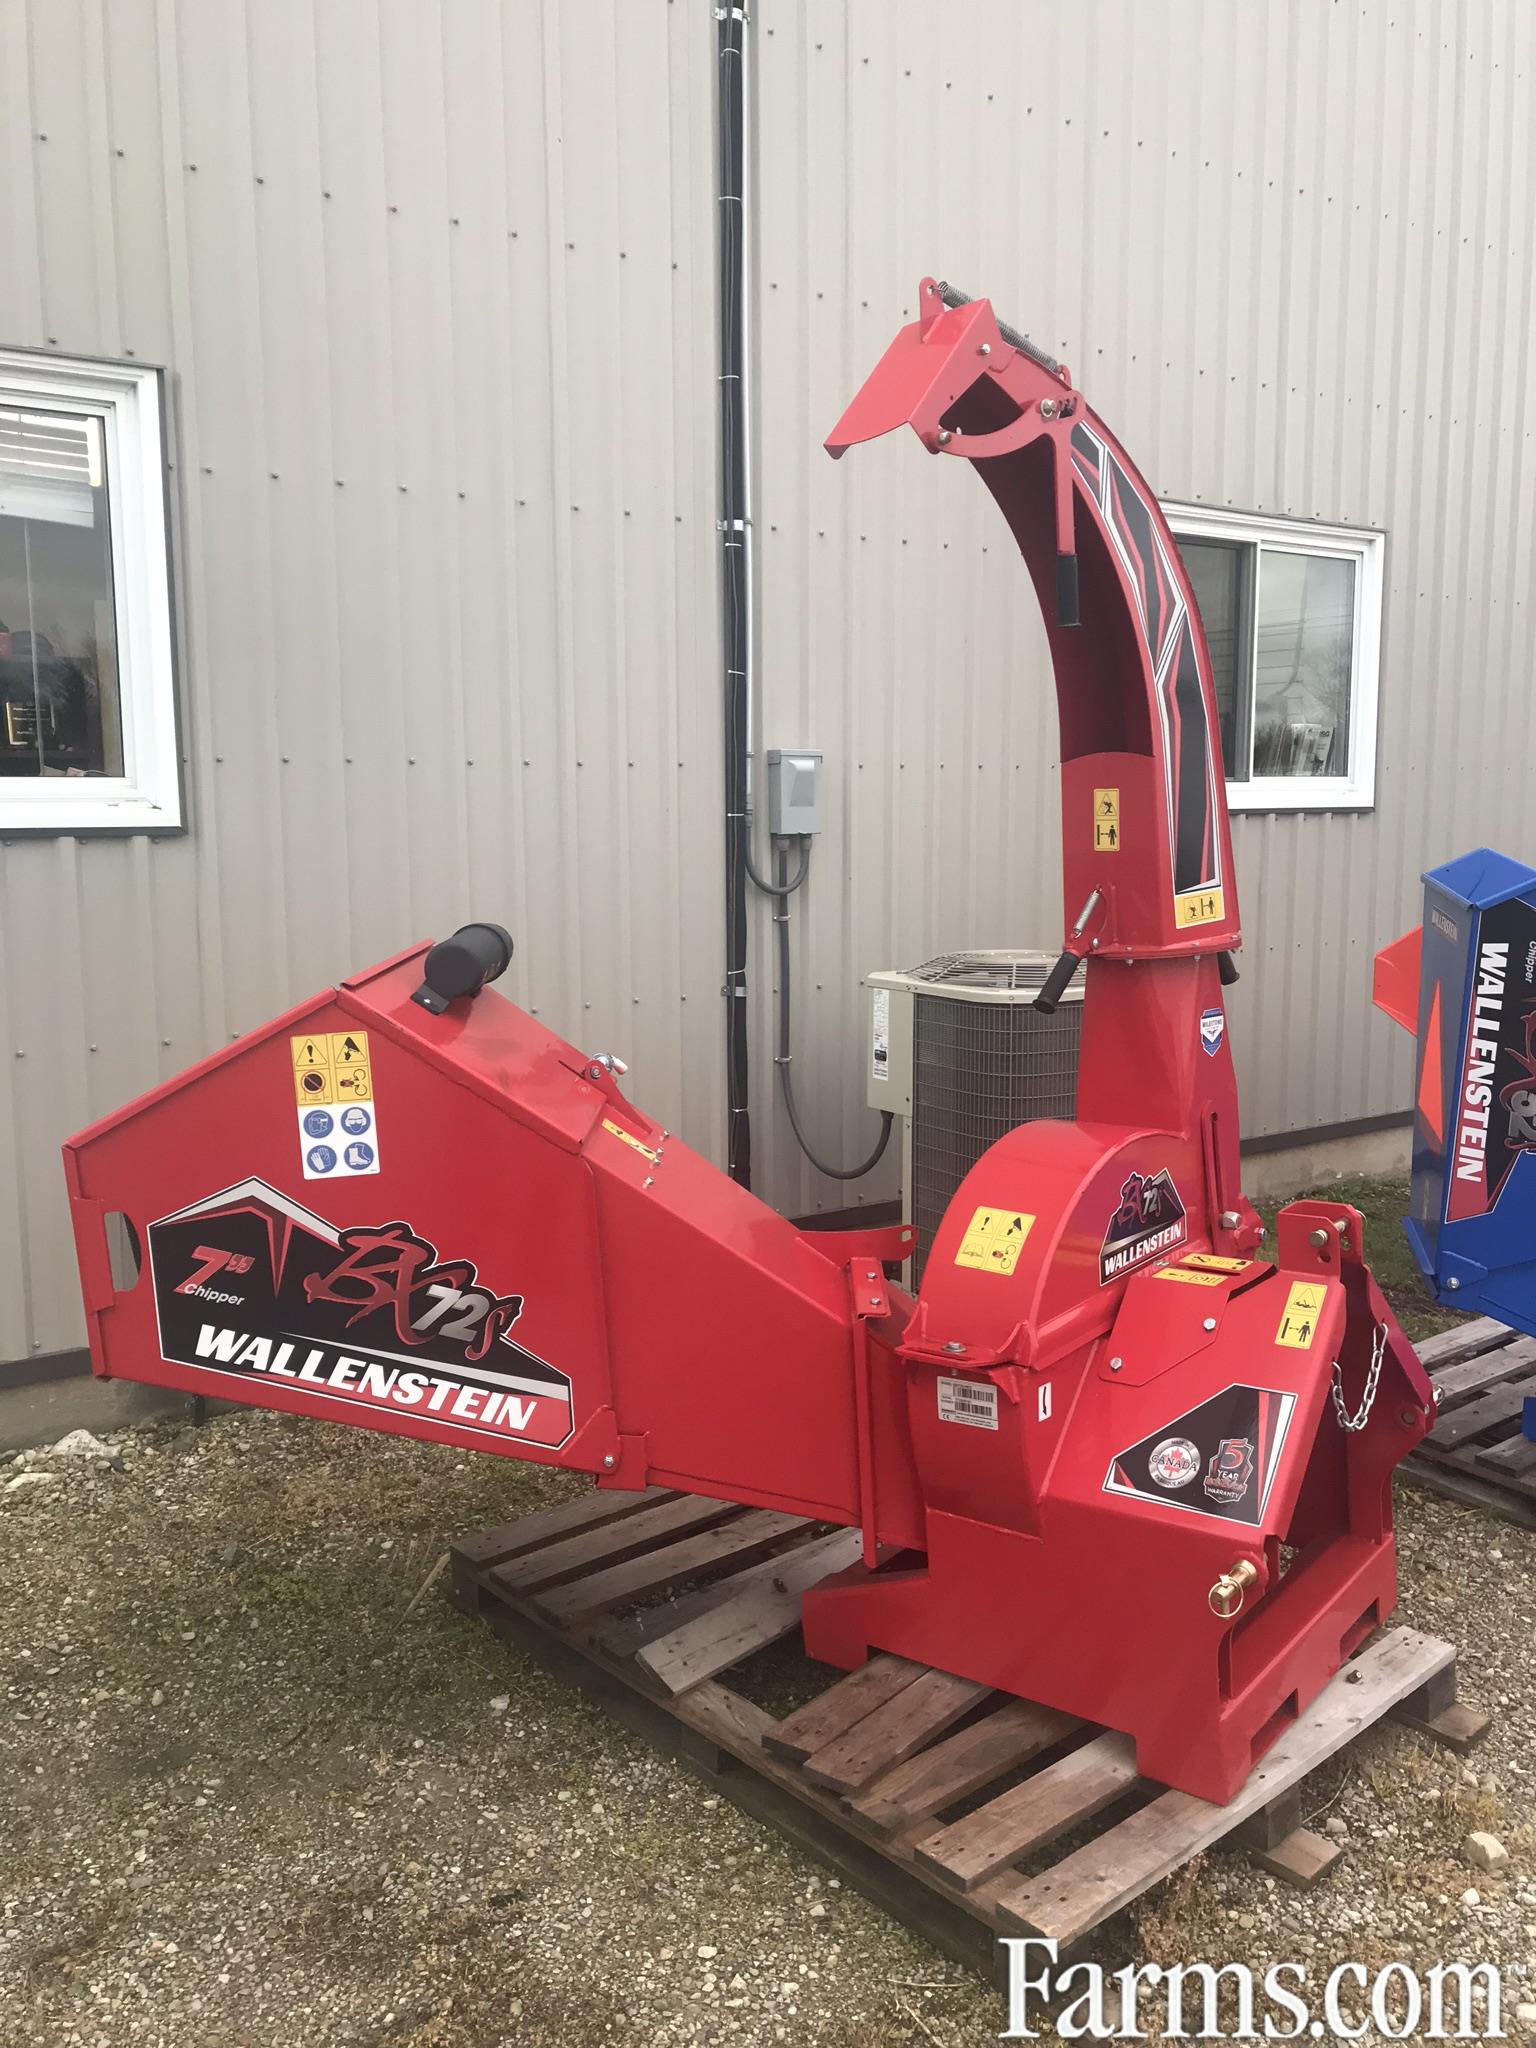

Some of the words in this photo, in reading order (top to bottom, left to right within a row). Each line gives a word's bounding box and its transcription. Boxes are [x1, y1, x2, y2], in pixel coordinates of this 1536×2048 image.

[1456, 942, 1509, 1183] WALLENSTEIN
[1105, 1221, 1182, 1277] WALLENSTEIN
[184, 1283, 245, 1305] Chipper
[195, 1323, 538, 1431] WALLENSTEIN
[1151, 1454, 1198, 1472] CANADA
[1220, 1440, 1245, 1469] 5
[1217, 1469, 1239, 1481] YEAR
[1207, 1487, 1240, 1499] WARRANTY
